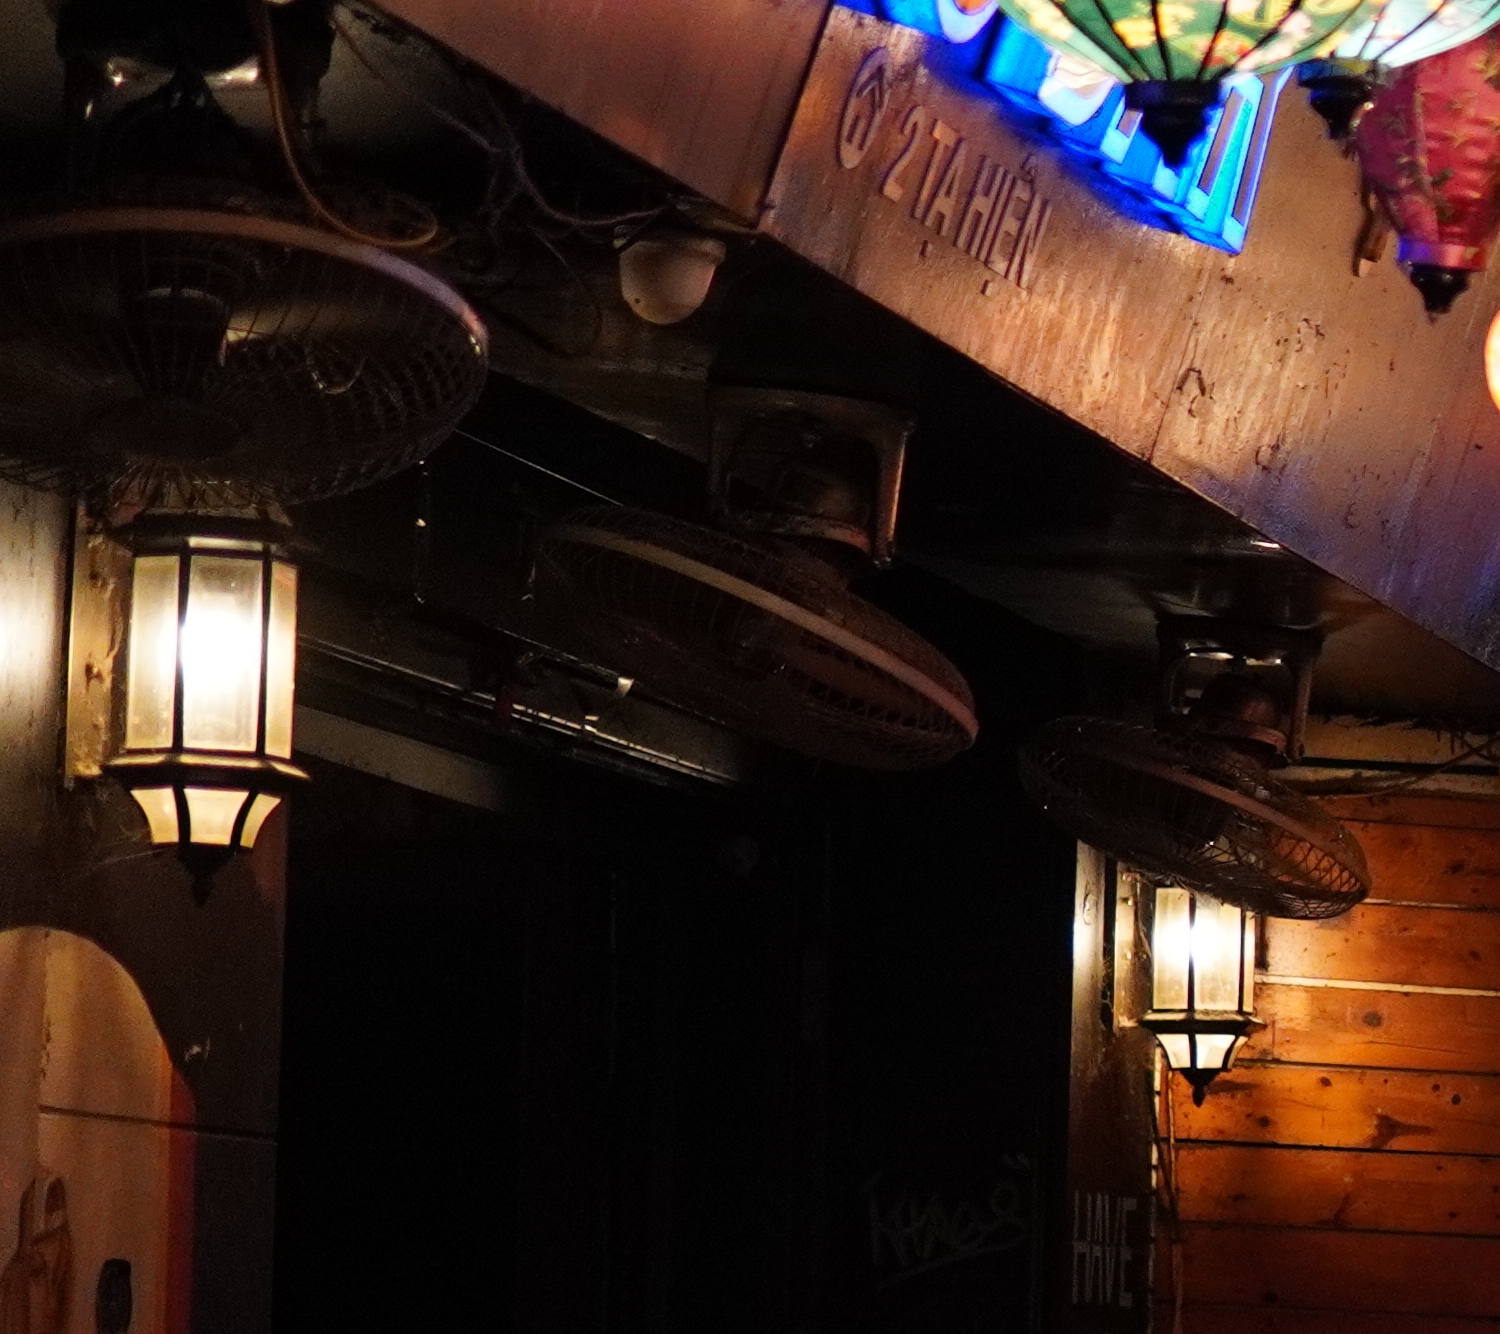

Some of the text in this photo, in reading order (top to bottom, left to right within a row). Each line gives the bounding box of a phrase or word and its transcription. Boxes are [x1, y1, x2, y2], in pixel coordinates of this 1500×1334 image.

[880, 104, 927, 204] 2
[952, 153, 1052, 296] HIỆN
[1071, 1190, 1137, 1309] HAVE
